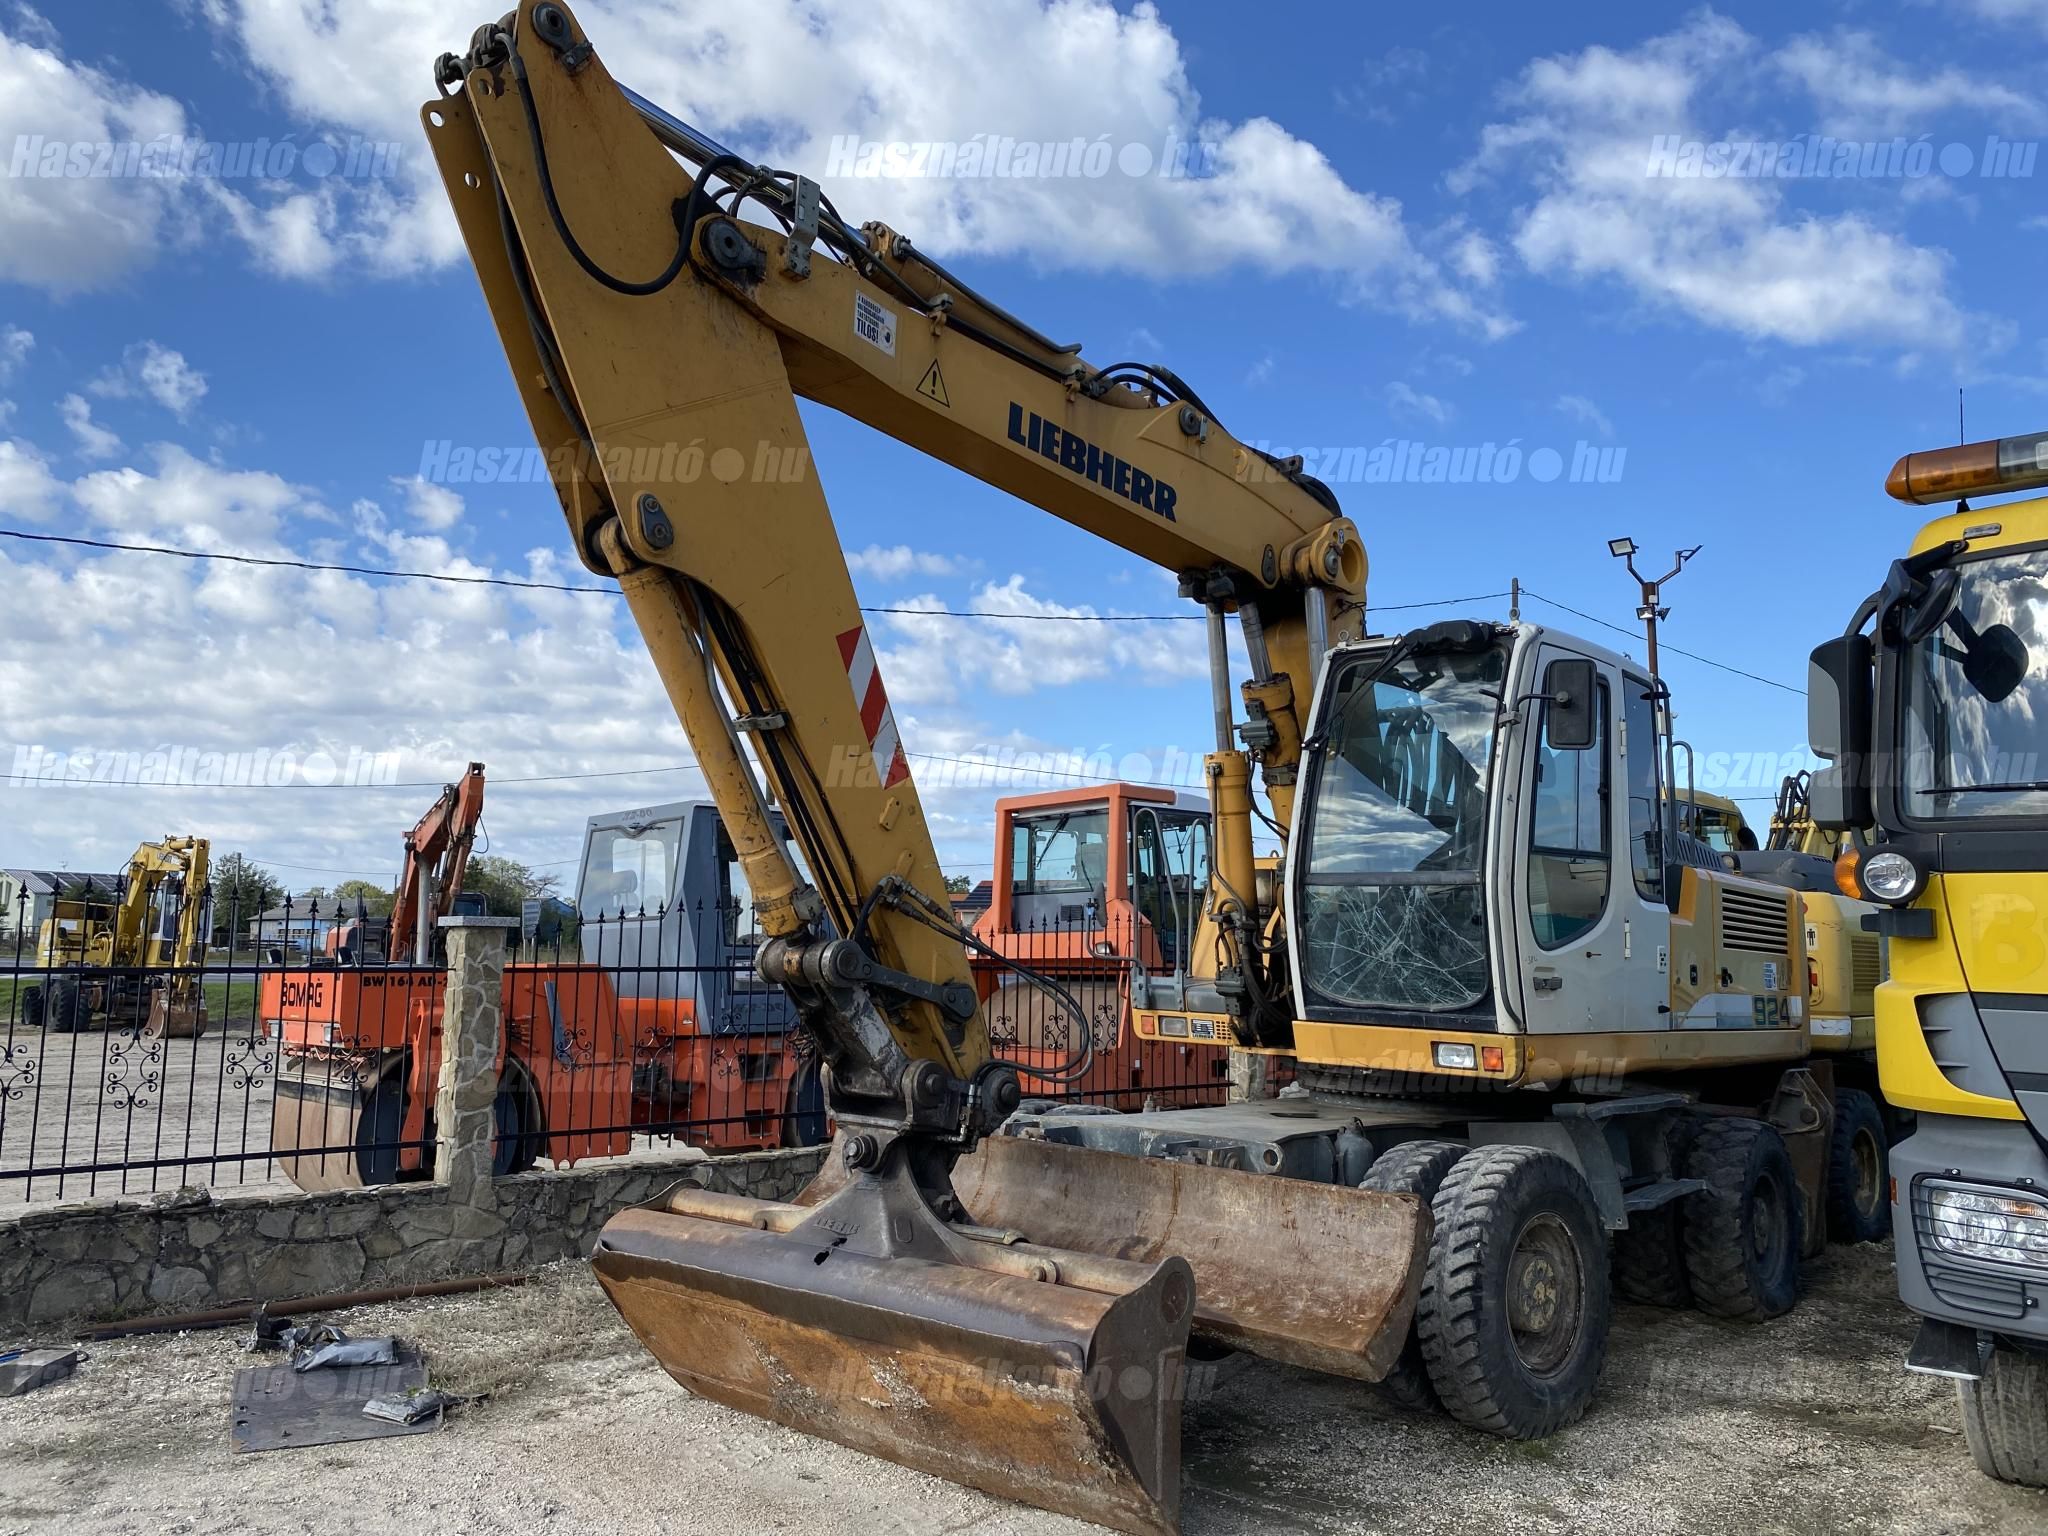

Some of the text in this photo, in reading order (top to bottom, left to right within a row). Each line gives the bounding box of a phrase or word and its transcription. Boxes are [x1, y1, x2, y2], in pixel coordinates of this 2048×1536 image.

[856, 316, 879, 344] TILOS!
[1007, 401, 1177, 523] LIEBHERR
[363, 975, 385, 987] BW
[281, 982, 323, 1008] BOMAG
